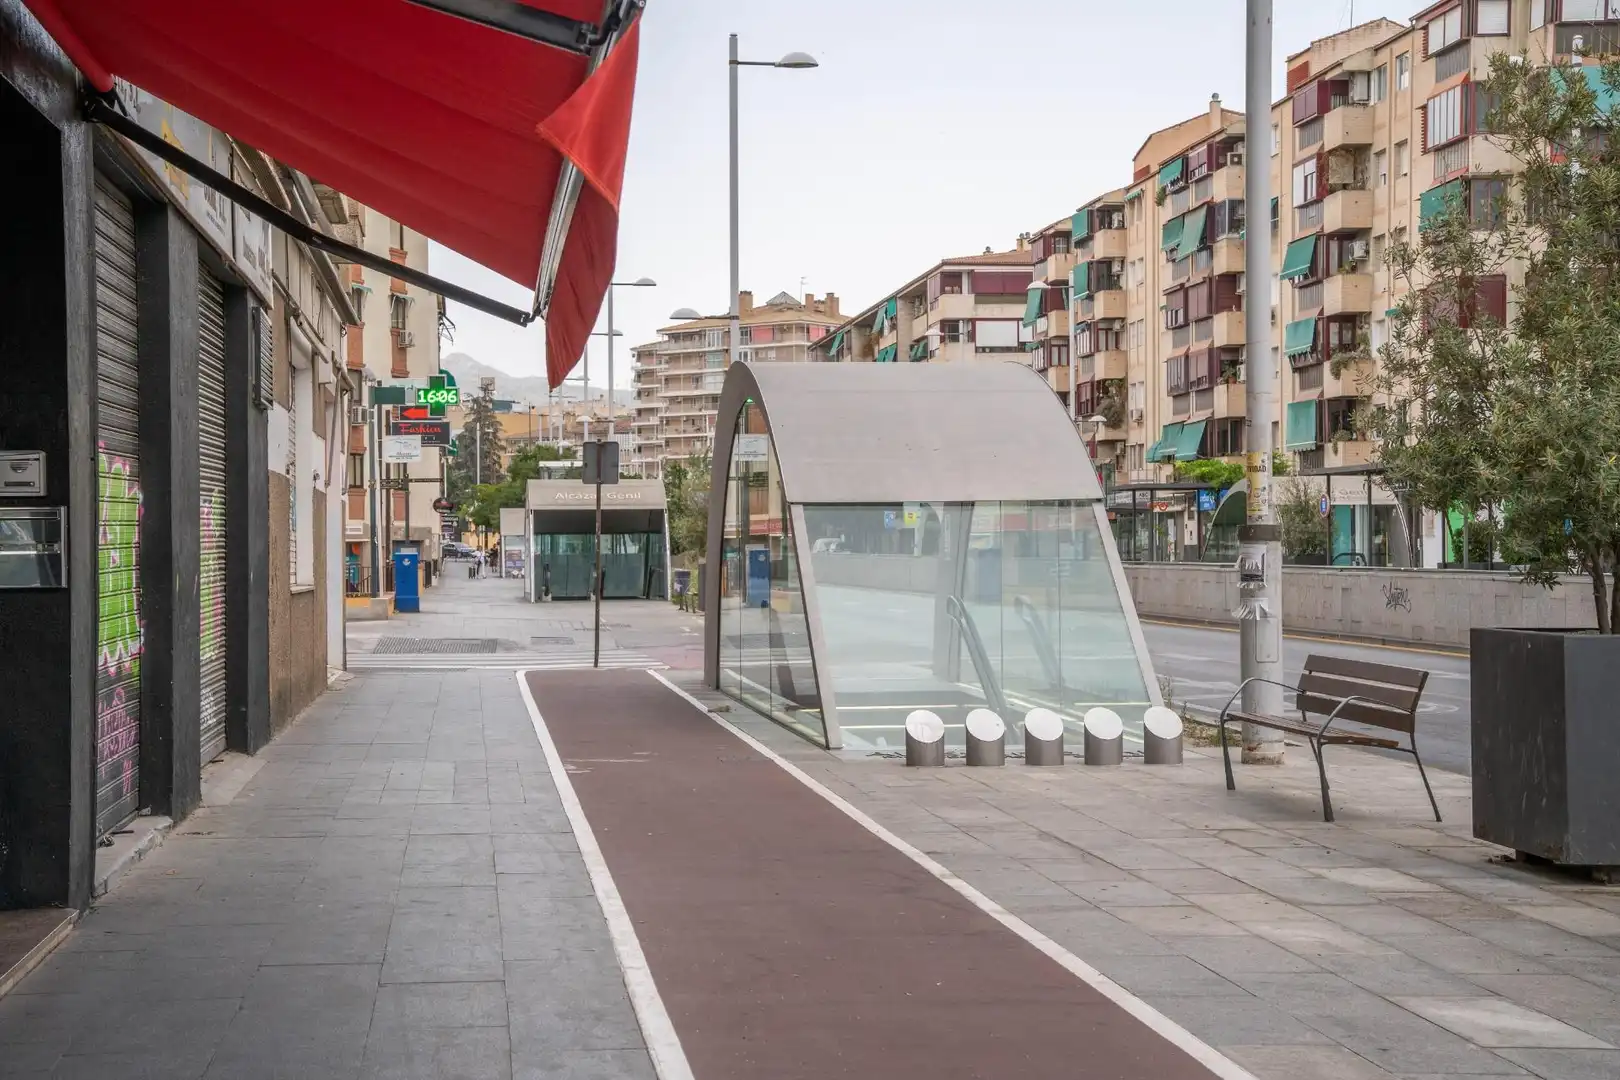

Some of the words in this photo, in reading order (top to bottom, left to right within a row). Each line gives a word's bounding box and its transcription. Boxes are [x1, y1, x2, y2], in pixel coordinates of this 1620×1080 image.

[418, 390, 457, 403] 16:06
[555, 491, 600, 500] Alcaza
[607, 491, 641, 500] Genil
